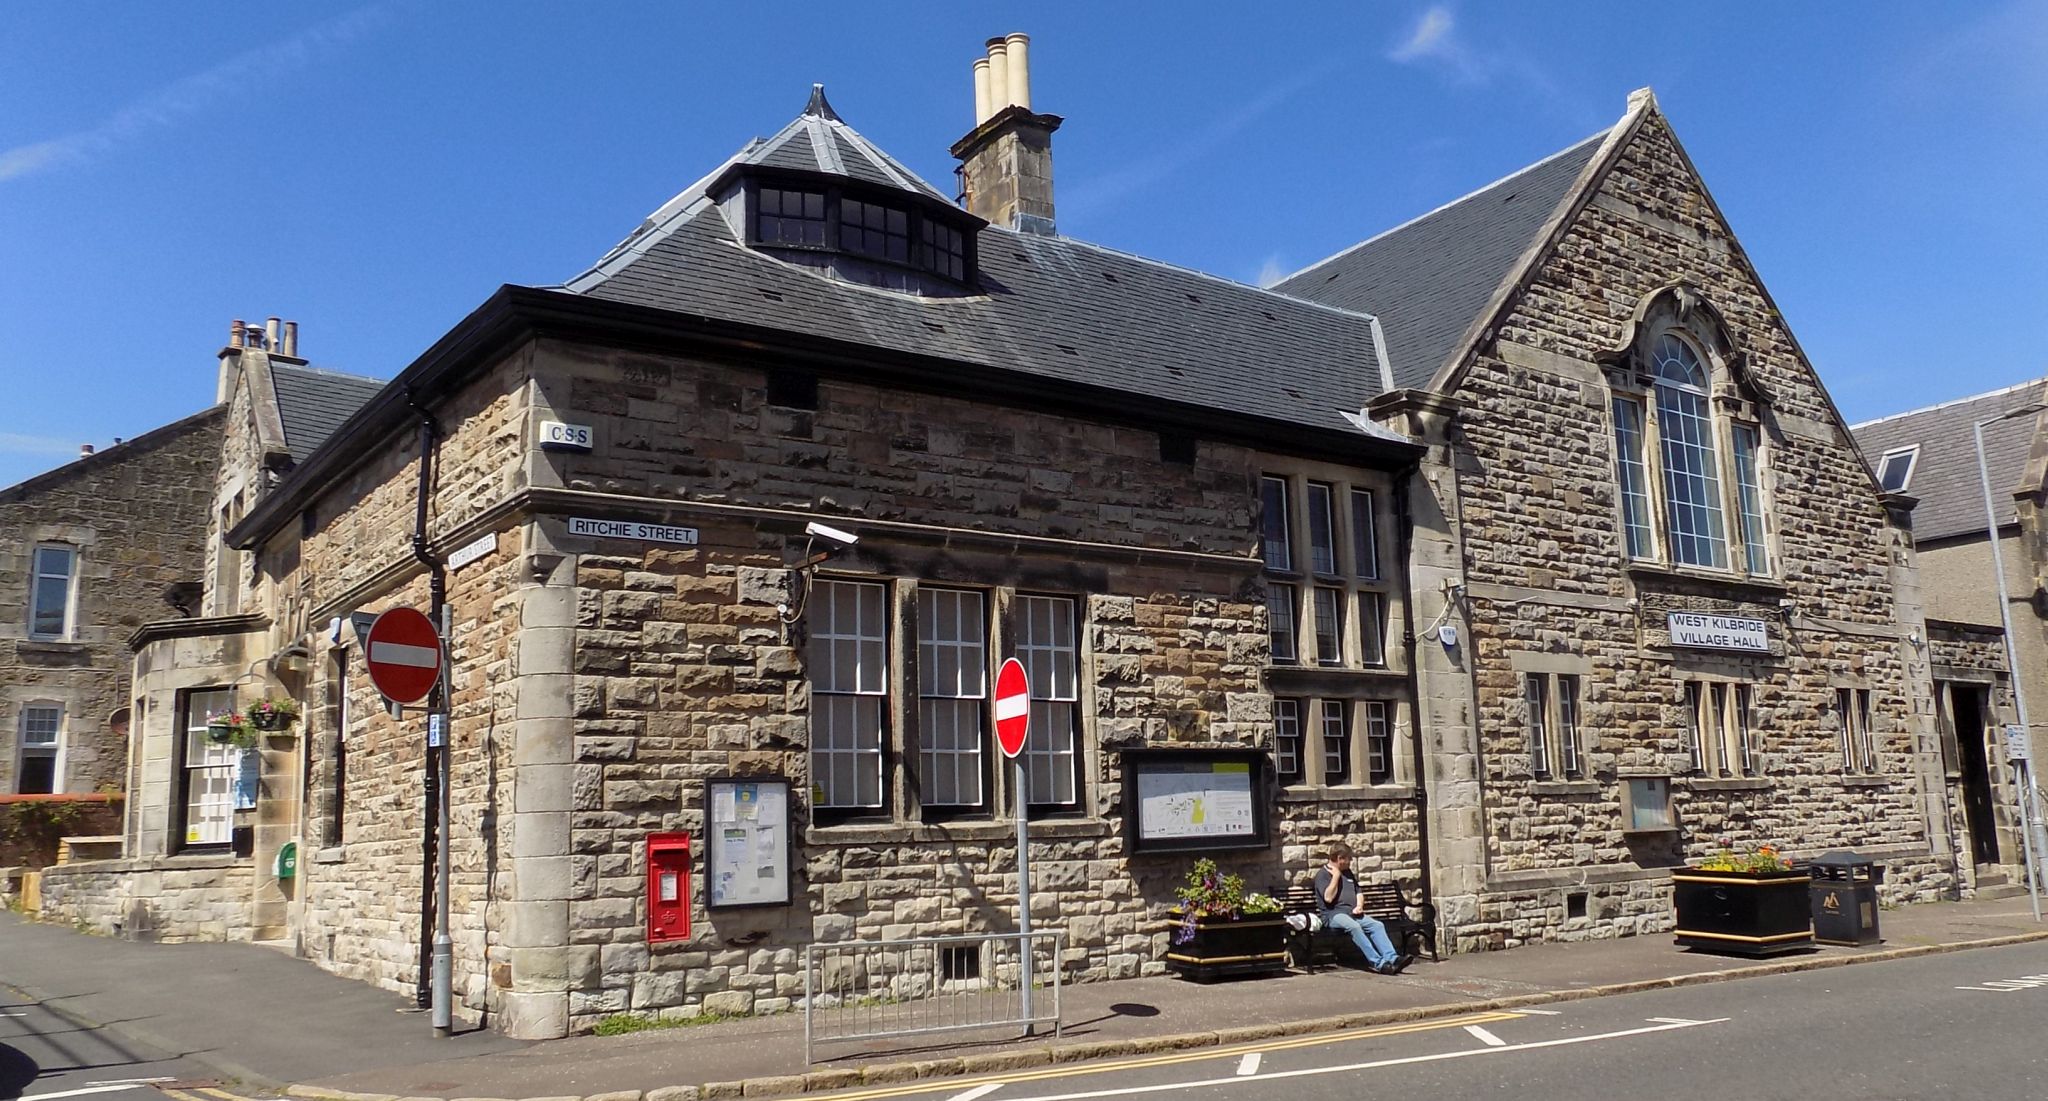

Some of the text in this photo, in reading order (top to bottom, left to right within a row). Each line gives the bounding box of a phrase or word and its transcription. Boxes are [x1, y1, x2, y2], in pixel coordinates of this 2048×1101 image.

[575, 520, 691, 542] RITCHIE STREET
[1673, 614, 1764, 632] WEST KILBRIDE
[1680, 632, 1762, 648] VILLAGE HALL
